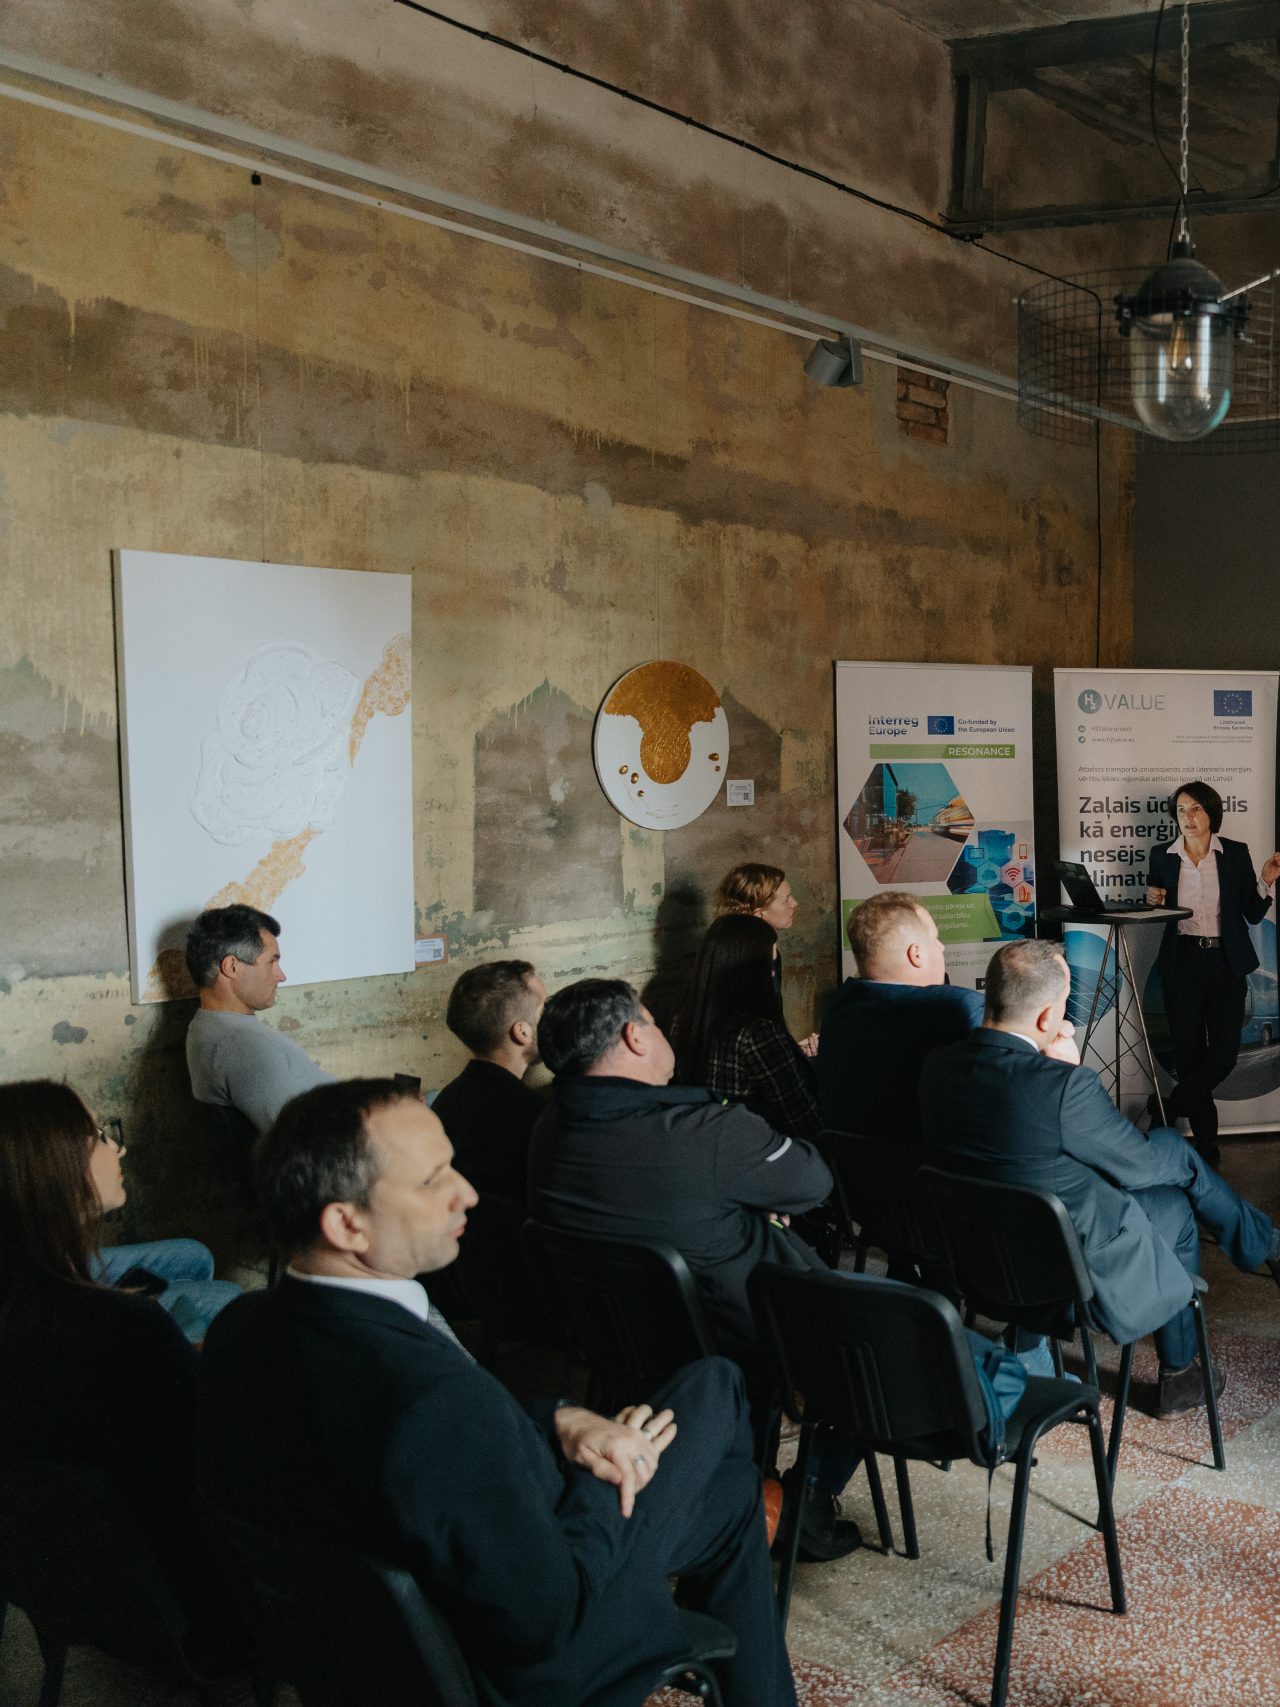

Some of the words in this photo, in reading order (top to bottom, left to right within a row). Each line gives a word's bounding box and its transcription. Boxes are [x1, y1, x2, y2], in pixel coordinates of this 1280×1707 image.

[1104, 693, 1166, 711] VALUE
[868, 714, 919, 728] Interreg
[990, 719, 997, 727] by
[868, 727, 908, 737] Europe
[948, 746, 1011, 756] RESONANCE
[1079, 796, 1141, 820] Zaļais
[1079, 821, 1106, 839] kā
[1080, 845, 1146, 866] nesējs
